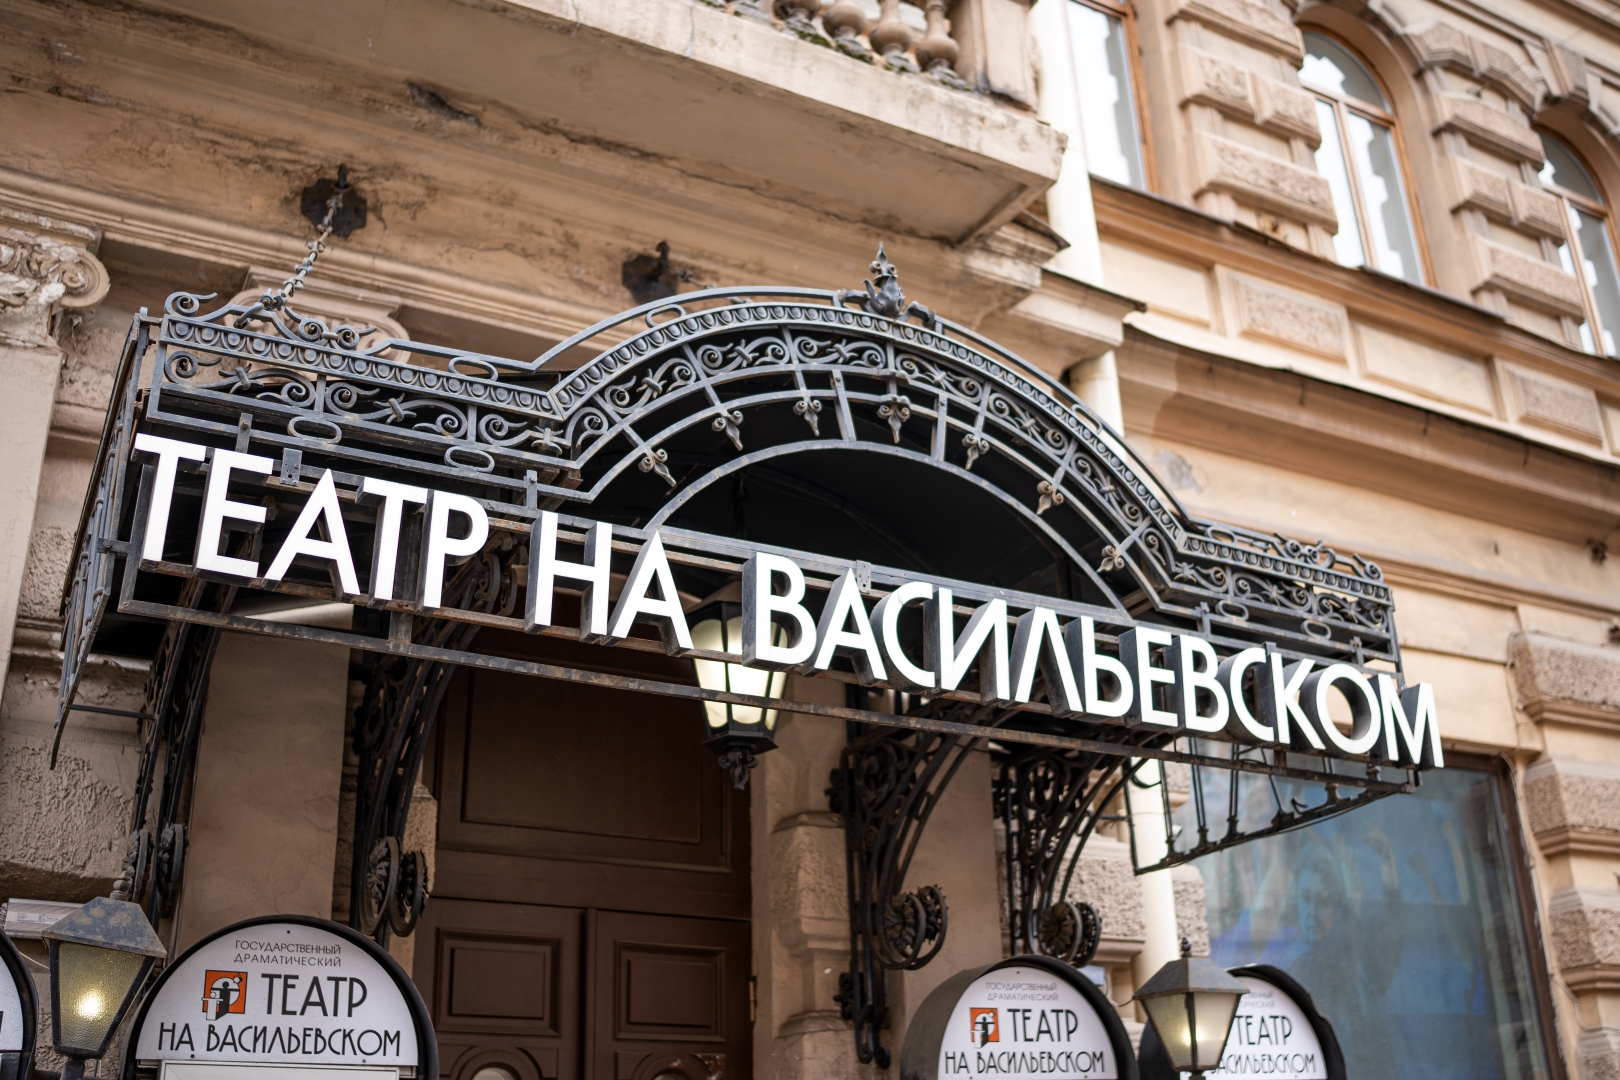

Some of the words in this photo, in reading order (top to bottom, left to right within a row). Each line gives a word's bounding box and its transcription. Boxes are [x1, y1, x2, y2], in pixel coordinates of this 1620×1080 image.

[134, 433, 490, 609] ТЕАТР
[531, 511, 694, 651] НА
[753, 551, 1444, 769] ВАСИЛЬЕВСКОМ
[234, 939, 342, 955] ГОСУДАРСТВЕННЫЙ
[233, 953, 342, 968] ДРАМАТИЧЕСКИЙ
[261, 973, 368, 1018] ТЕАТР
[985, 981, 1058, 992] ГОСУДАРСТВЕННЫЙ
[986, 992, 1059, 1002] ДРАМАТИЧЕСКИЙ
[1007, 1008, 1079, 1043] ТЕАТР
[1234, 1015, 1293, 1046] ТЕАТР
[158, 1022, 195, 1052] НА
[206, 1024, 401, 1057] ВАСИЛЬЕВСКОМ
[944, 1050, 971, 1074] НА
[976, 1050, 1106, 1075] ВАСИЛЬЕВСКОМ
[1210, 1053, 1317, 1075] АСИЛЬЕВСКОМ
